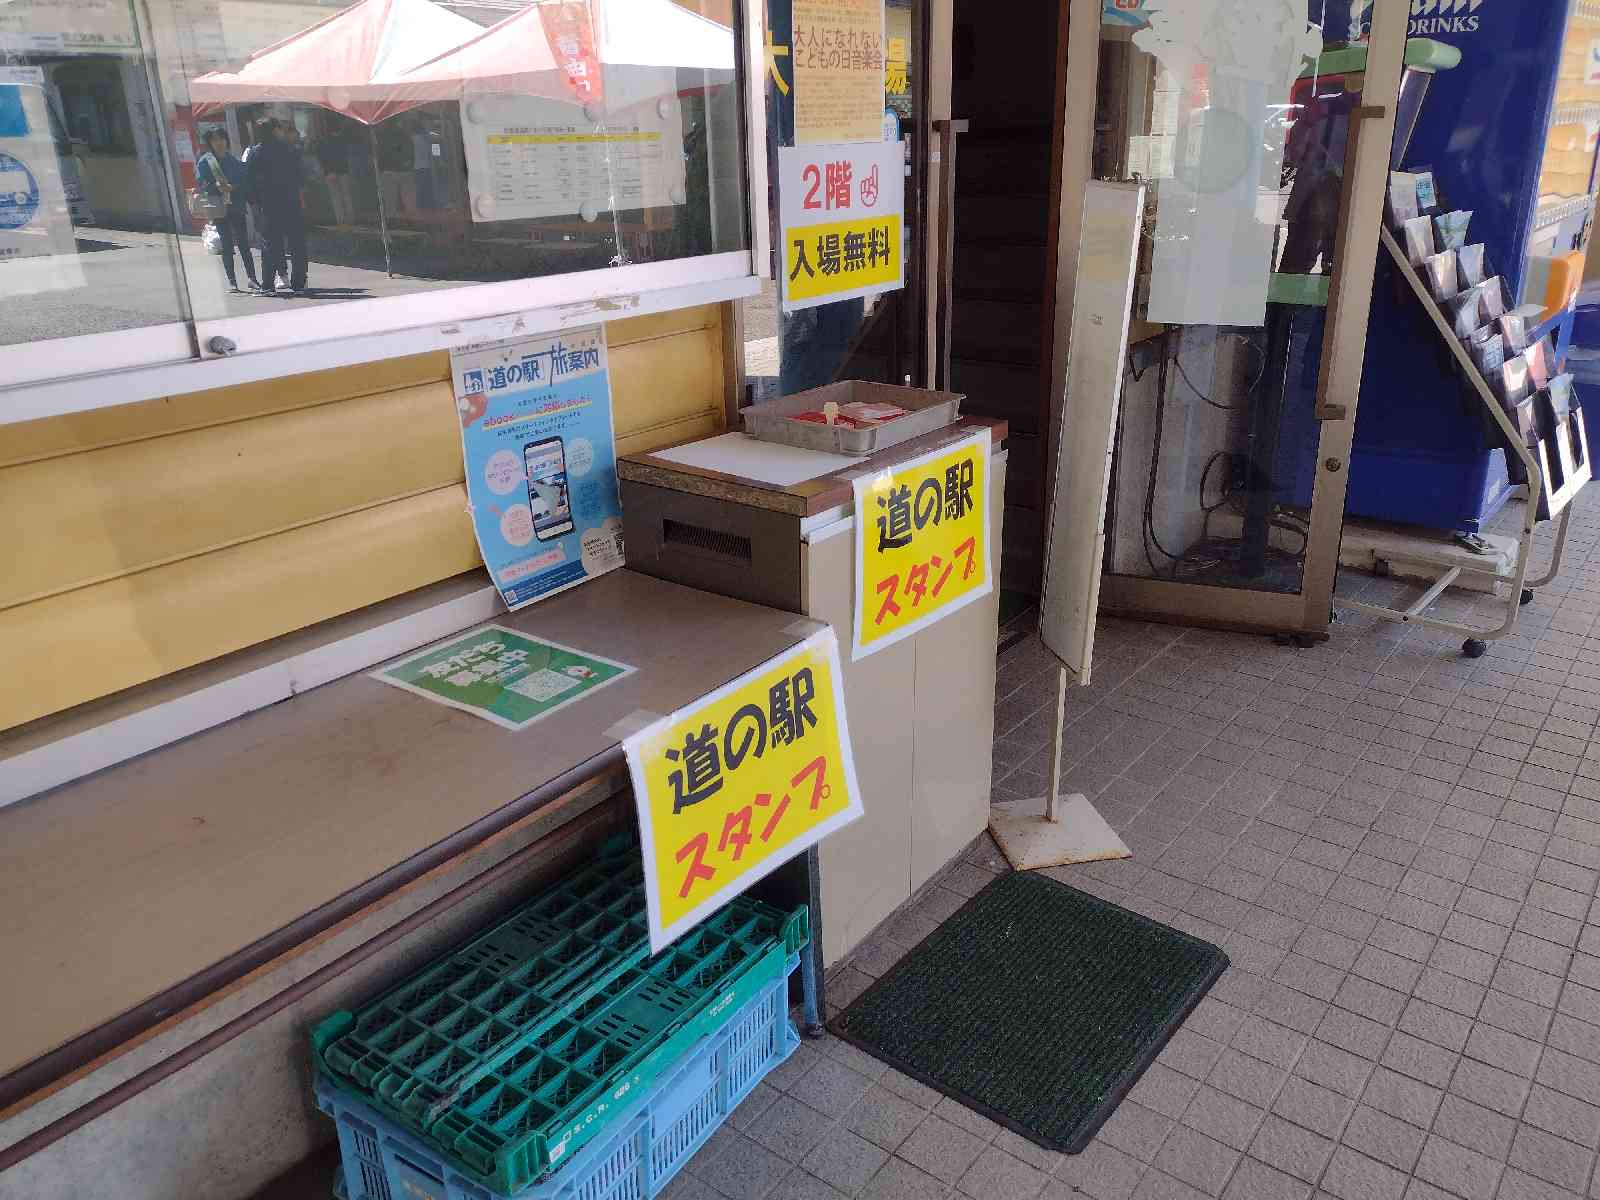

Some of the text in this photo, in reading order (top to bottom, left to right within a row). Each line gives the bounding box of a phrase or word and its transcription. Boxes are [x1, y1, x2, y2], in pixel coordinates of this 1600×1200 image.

[794, 25, 882, 50] 大人になれない
[794, 46, 883, 72] こどもの日音楽会
[802, 160, 853, 211] 2階
[790, 226, 891, 282] 入場無料
[488, 359, 541, 391] 道の駅
[876, 458, 975, 553] 道の駅
[874, 536, 977, 625] スタンプ
[665, 667, 818, 815] 道の駅
[674, 755, 832, 899] スタンプ
